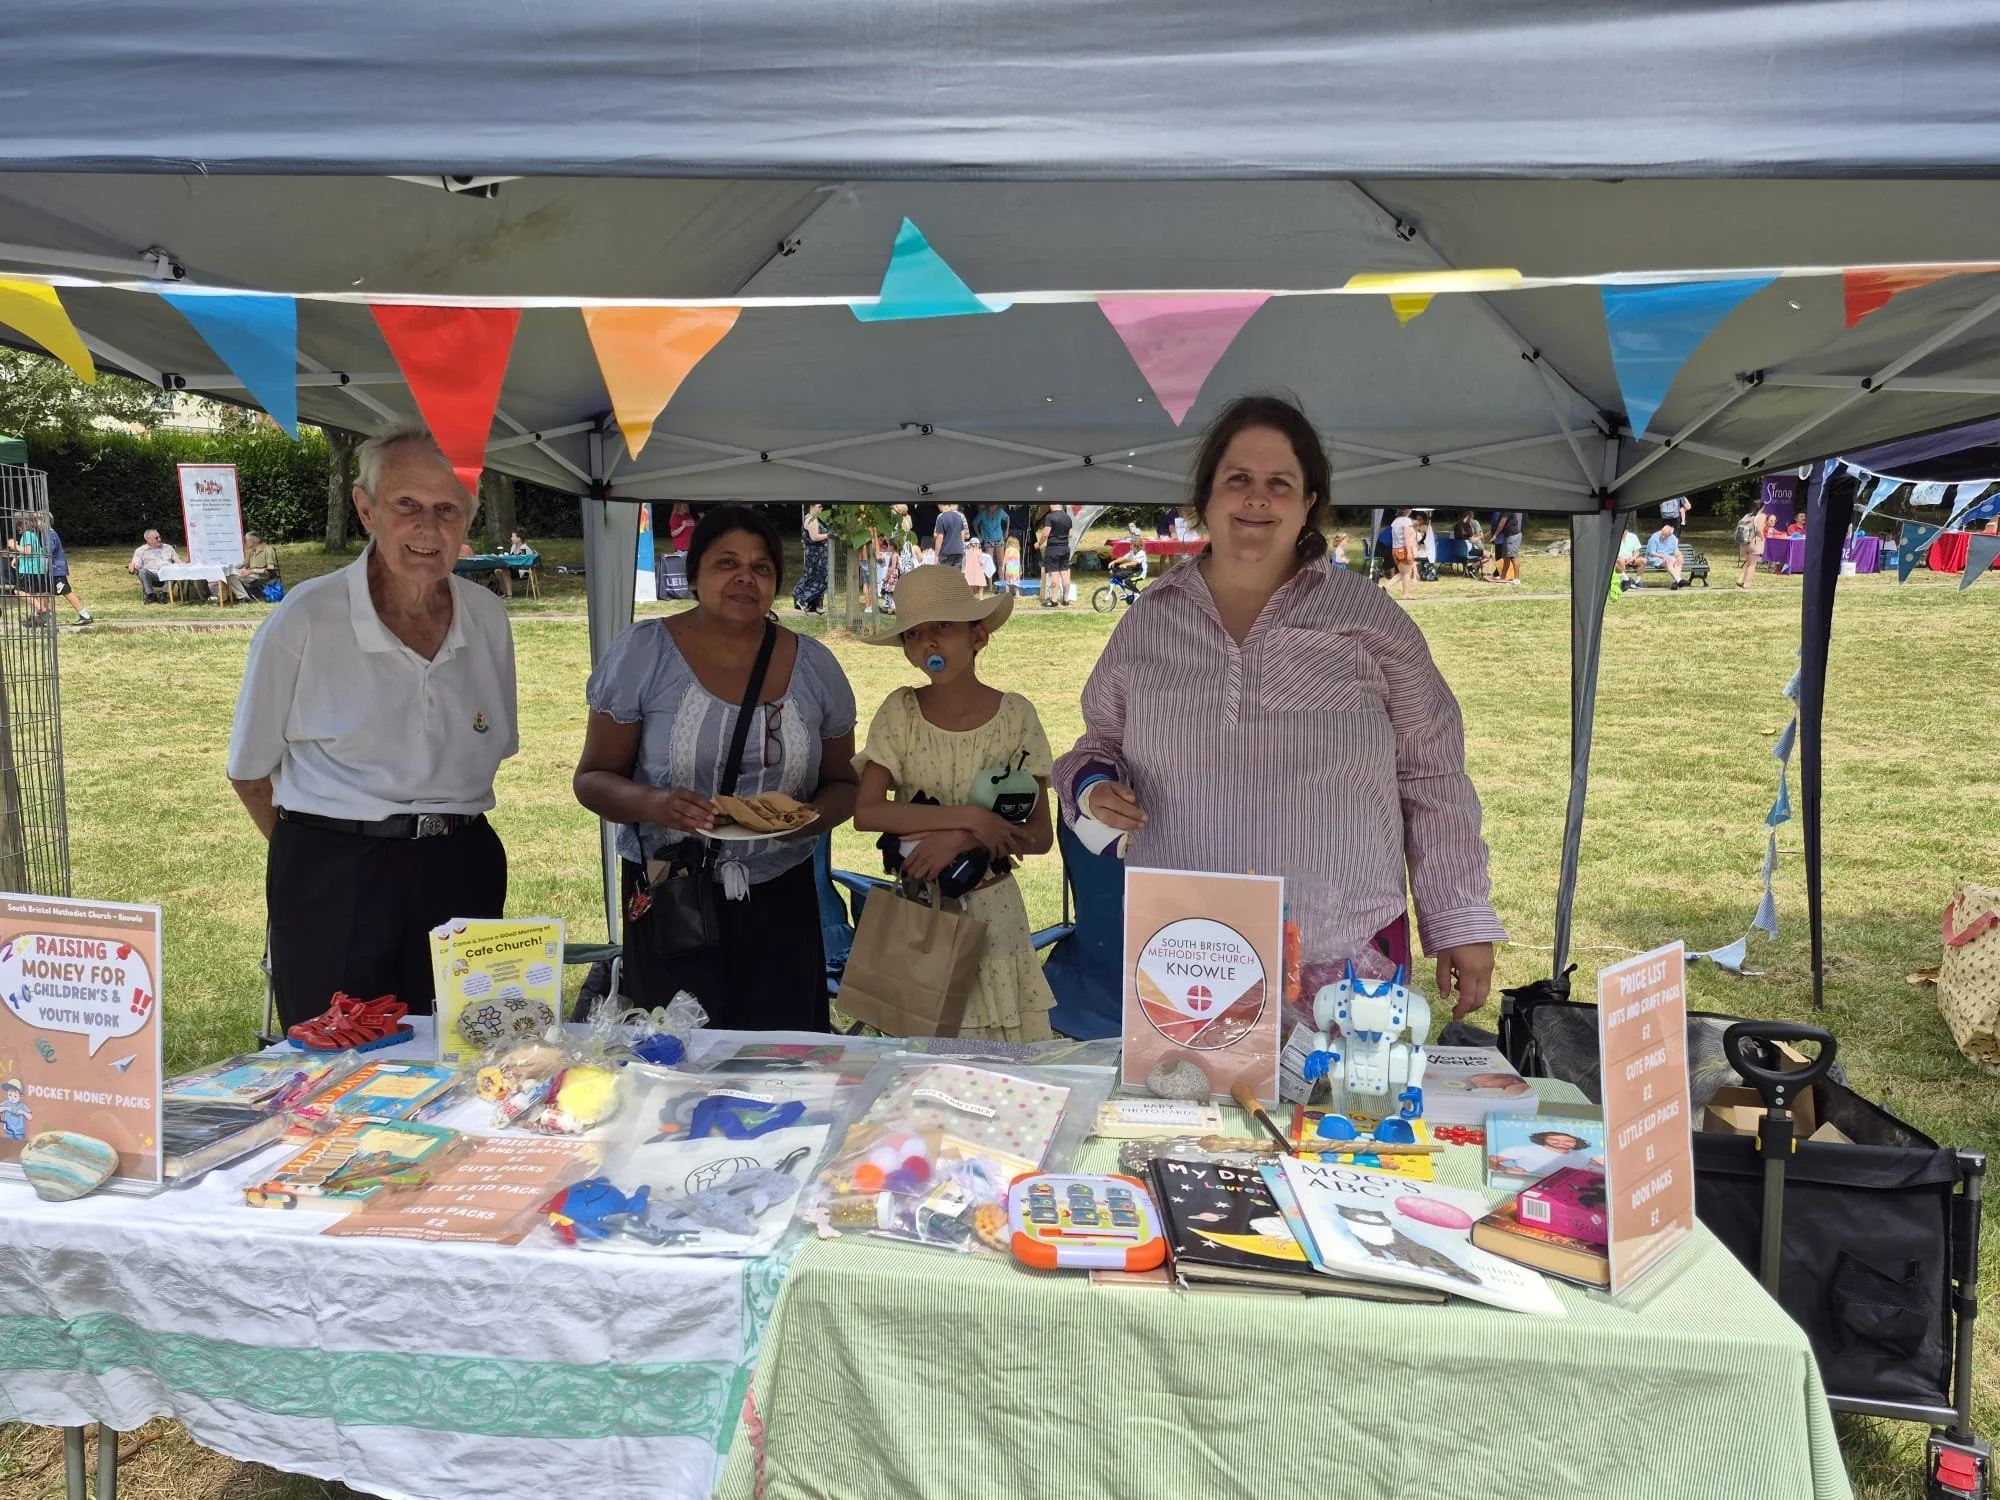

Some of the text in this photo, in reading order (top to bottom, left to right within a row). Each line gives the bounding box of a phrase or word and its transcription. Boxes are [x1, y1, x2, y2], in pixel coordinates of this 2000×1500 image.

[1764, 482, 1792, 504] Sirona
[8, 904, 27, 913] South
[28, 905, 51, 915] Bristol
[53, 907, 87, 918] Methodist
[88, 911, 112, 921] Church
[118, 913, 143, 923] Knowle
[36, 936, 107, 960] RAISING
[466, 946, 493, 958] Cafe
[496, 936, 543, 953] Church!
[1148, 948, 1255, 965] METHODIST CHURCH
[1162, 938, 1241, 954] SOUTH BRISTOL
[22, 959, 126, 986] MONEY FOR
[1166, 962, 1236, 980] KNOWLE
[1620, 959, 1666, 997] PRICE LIST
[34, 982, 121, 1003] CHILDREN'S &
[39, 1006, 119, 1028] YOUTH WORK
[1608, 984, 1680, 1030] ARTS AND CRAFT PACKS
[1626, 1047, 1667, 1081] CUTE PACKS
[28, 1084, 151, 1110] POCKET MONEY PACKS
[1618, 1100, 1680, 1150] LITTLE KID PACKS
[486, 1138, 585, 1149] PRICE LIST
[458, 1164, 545, 1173] CUTE PACKS
[1168, 1163, 1207, 1180] My
[468, 1184, 496, 1192] KID
[1204, 1181, 1268, 1196] Lauren
[1301, 1164, 1422, 1195] MOG'S
[1308, 1178, 1385, 1199] ABC
[1631, 1169, 1673, 1210] BOOK PACKS
[400, 1206, 497, 1220] BOOK PACKS
[425, 1218, 449, 1227] £2
[1651, 1208, 1660, 1227] £2
